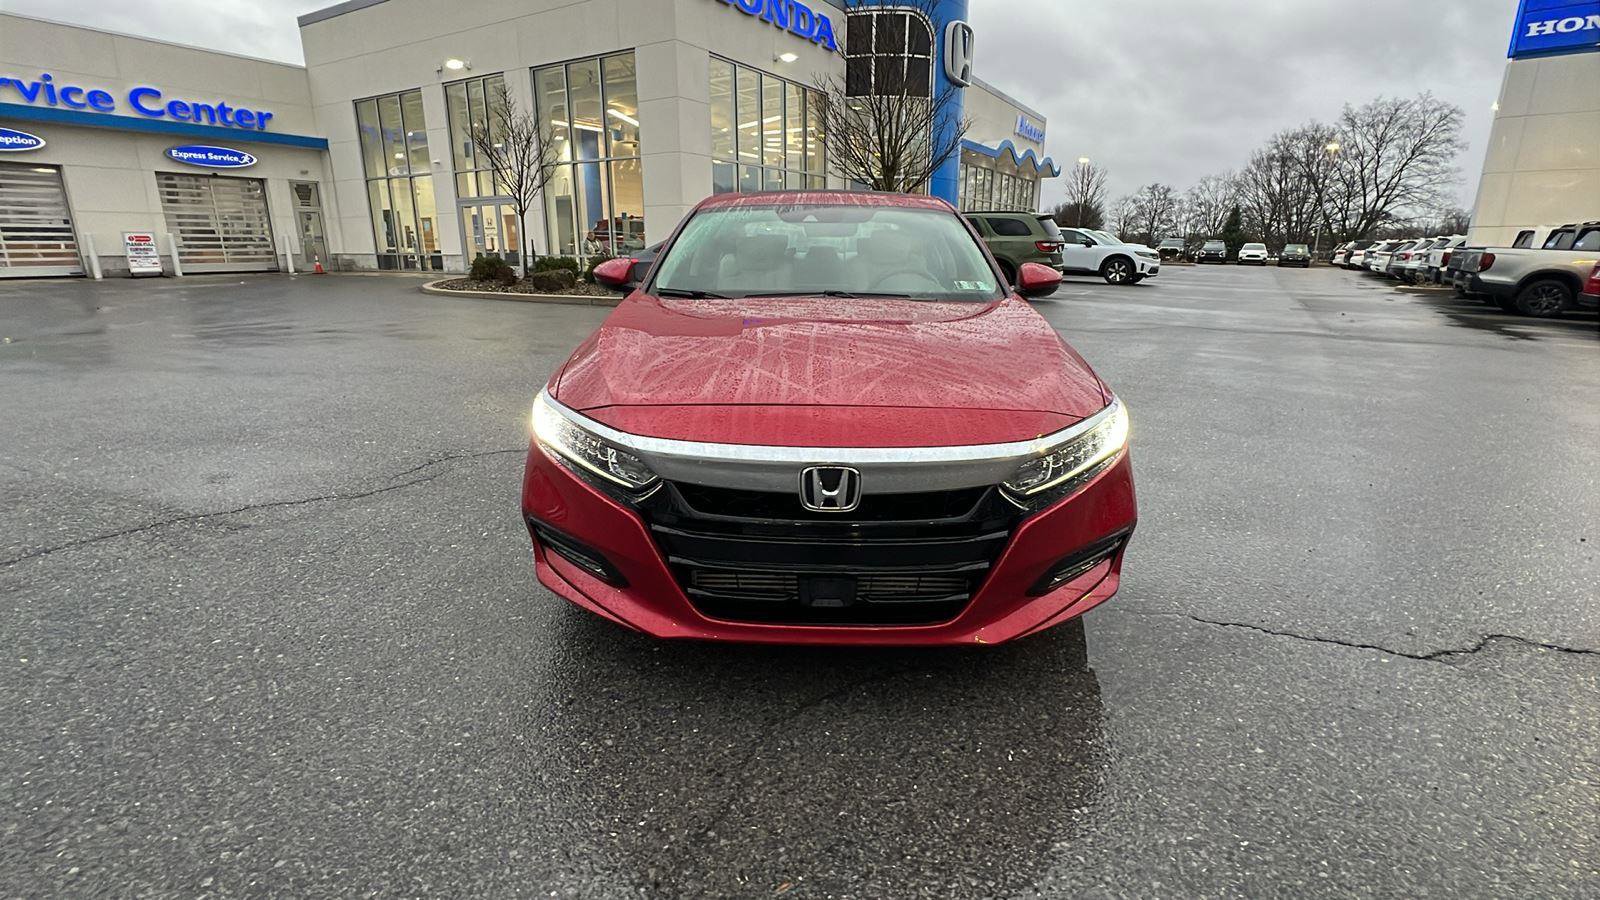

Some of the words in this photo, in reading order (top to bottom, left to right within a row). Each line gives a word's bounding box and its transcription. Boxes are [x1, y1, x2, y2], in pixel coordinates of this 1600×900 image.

[716, 0, 837, 52] NDA
[128, 87, 273, 130] Center
[171, 149, 206, 160] Express
[207, 152, 239, 162] Service
